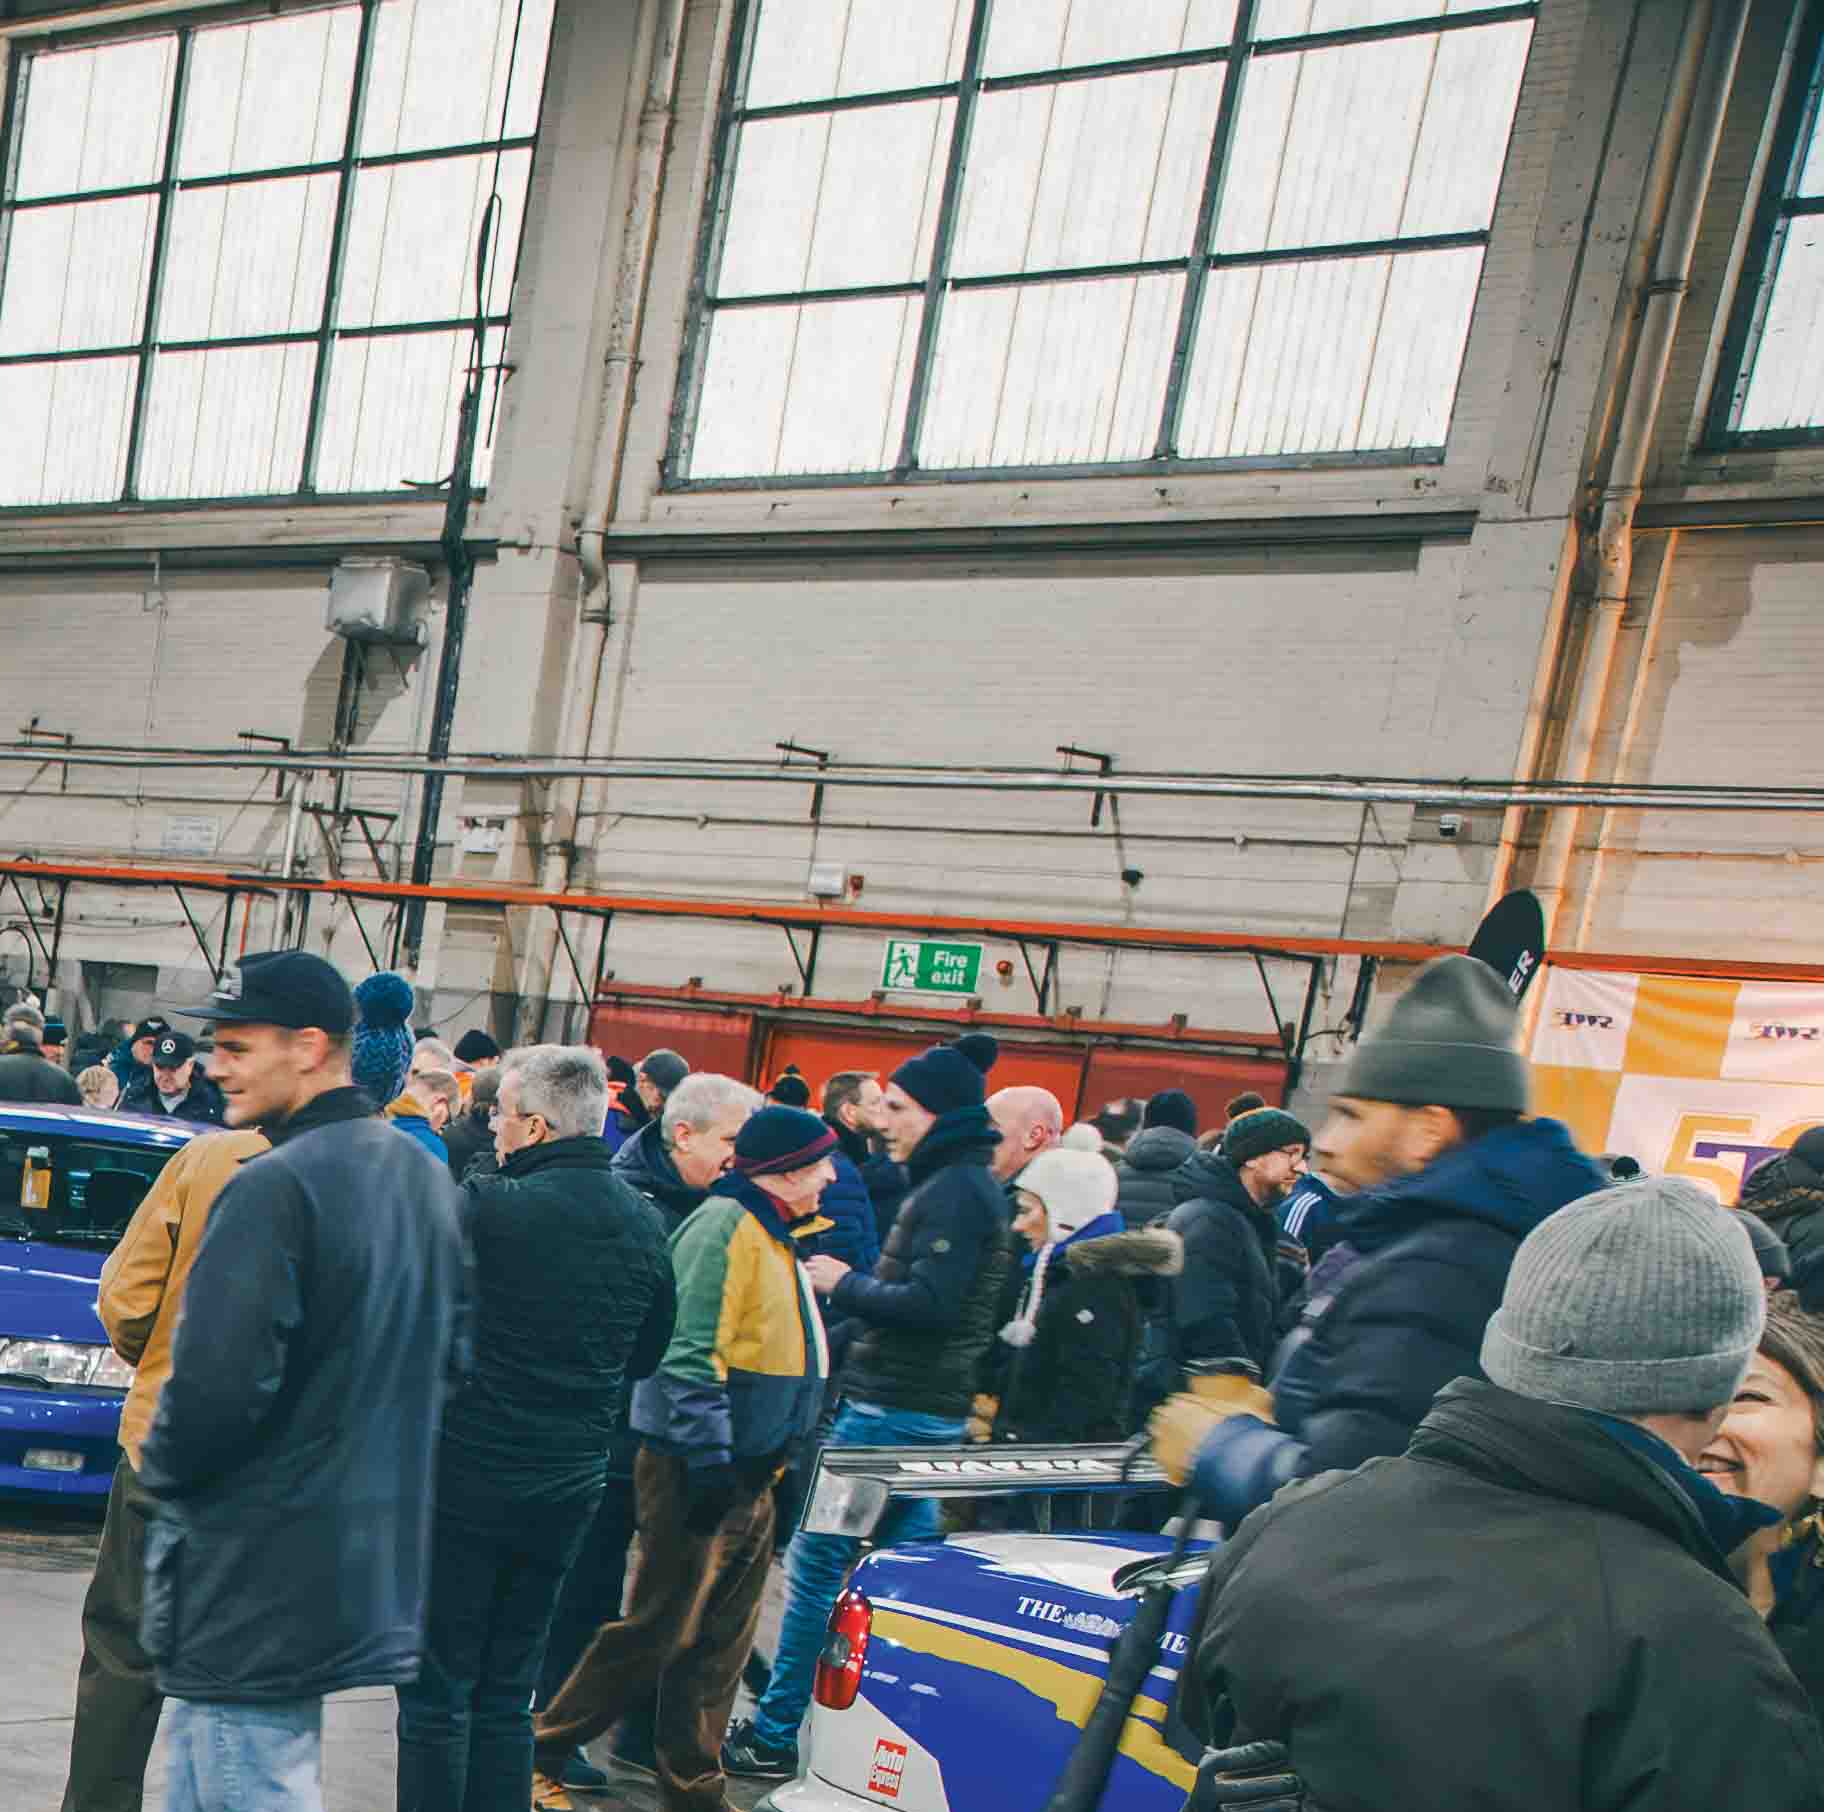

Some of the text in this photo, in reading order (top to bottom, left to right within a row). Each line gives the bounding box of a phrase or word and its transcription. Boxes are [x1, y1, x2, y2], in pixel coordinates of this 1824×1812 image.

[933, 950, 968, 969] Fire
[930, 969, 966, 986] exit
[1016, 1596, 1066, 1624] THE
